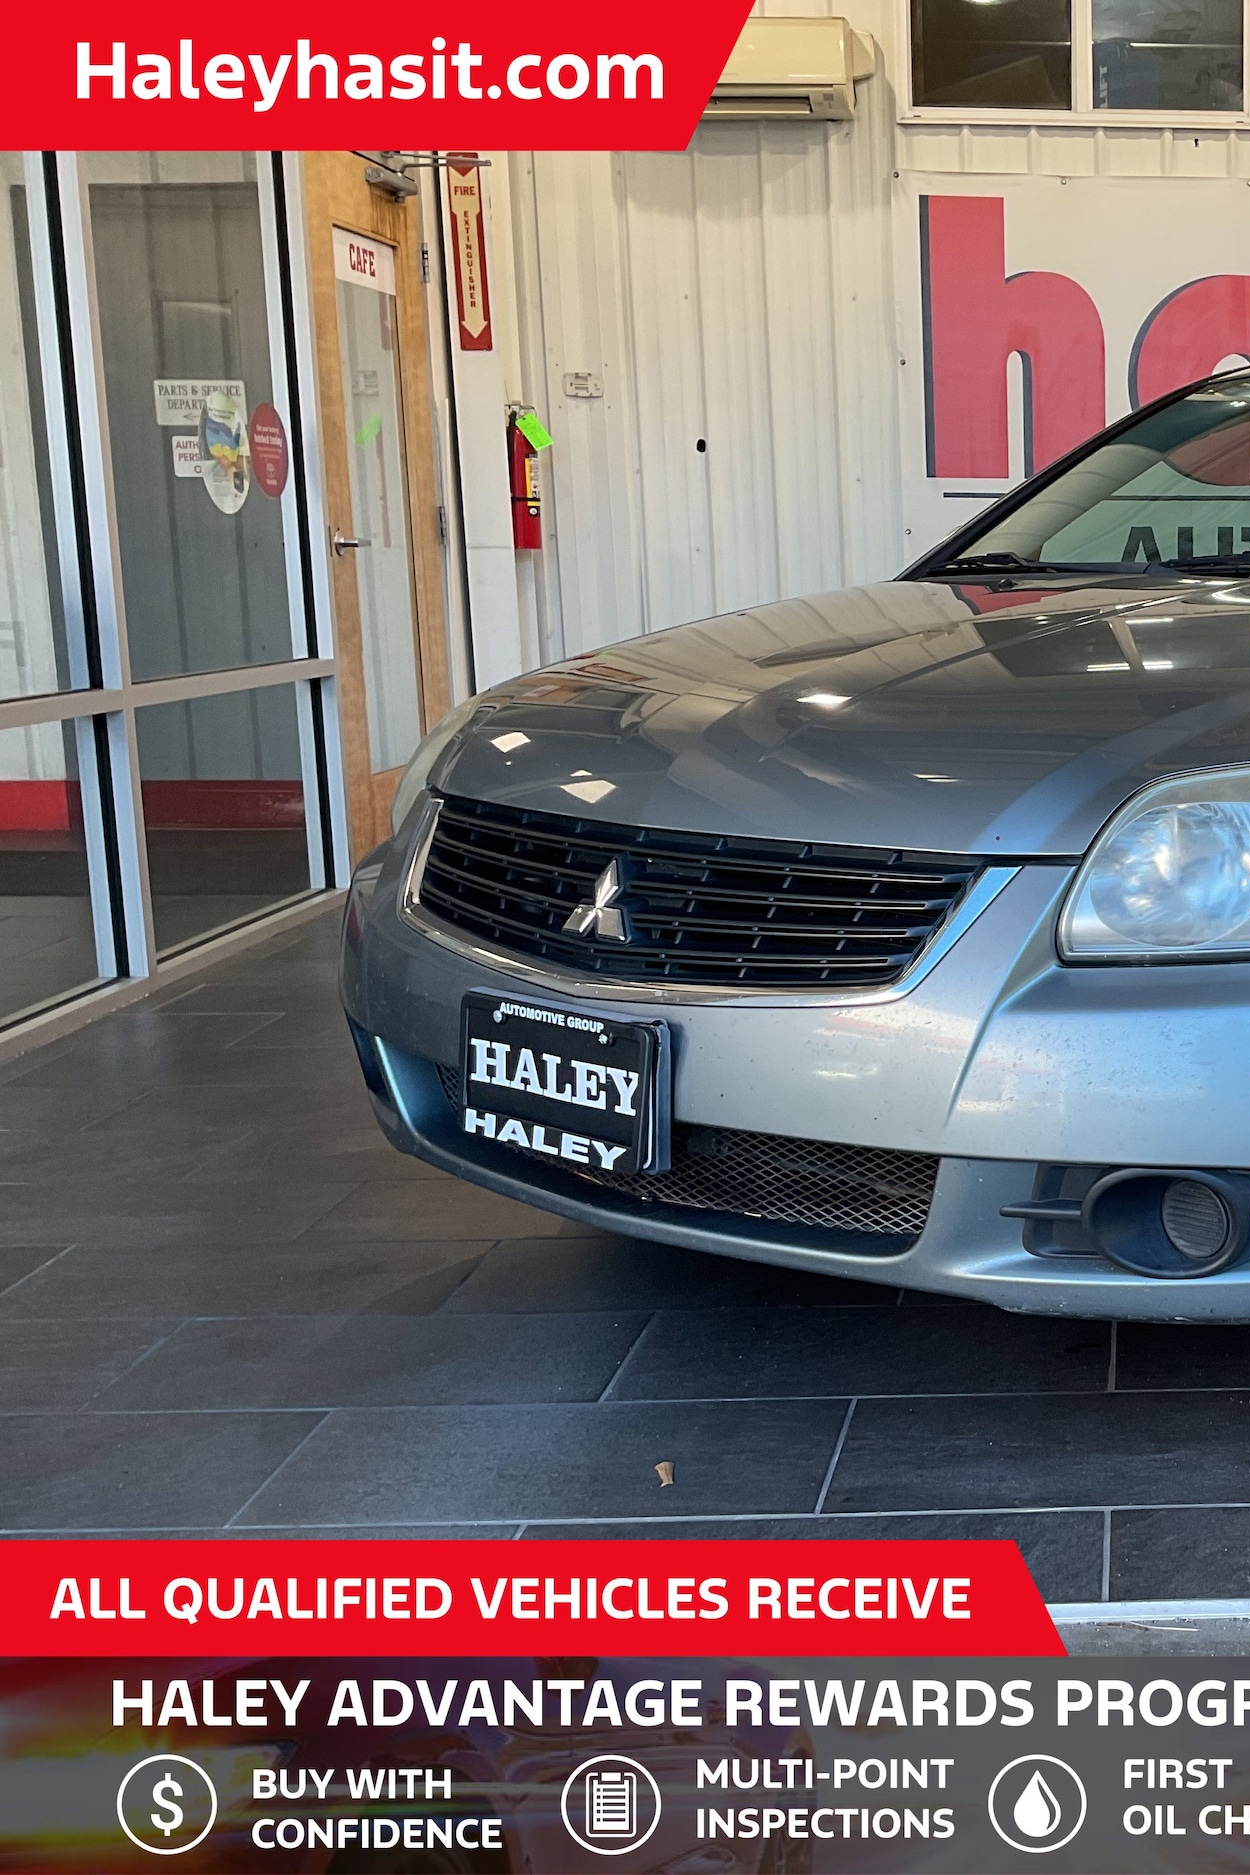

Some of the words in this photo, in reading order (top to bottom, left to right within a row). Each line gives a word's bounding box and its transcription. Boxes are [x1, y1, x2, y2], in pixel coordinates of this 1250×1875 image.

[453, 185, 476, 197] FIRE
[349, 243, 376, 277] CAFE
[463, 210, 477, 308] EXTINGUISHER
[158, 385, 188, 396] PARTS
[191, 385, 199, 396] &
[500, 1002, 565, 1027] AUTOMOTIVE
[567, 1015, 604, 1034] GROUP
[470, 1037, 639, 1117] HALEY
[464, 1106, 627, 1170] HALEY
